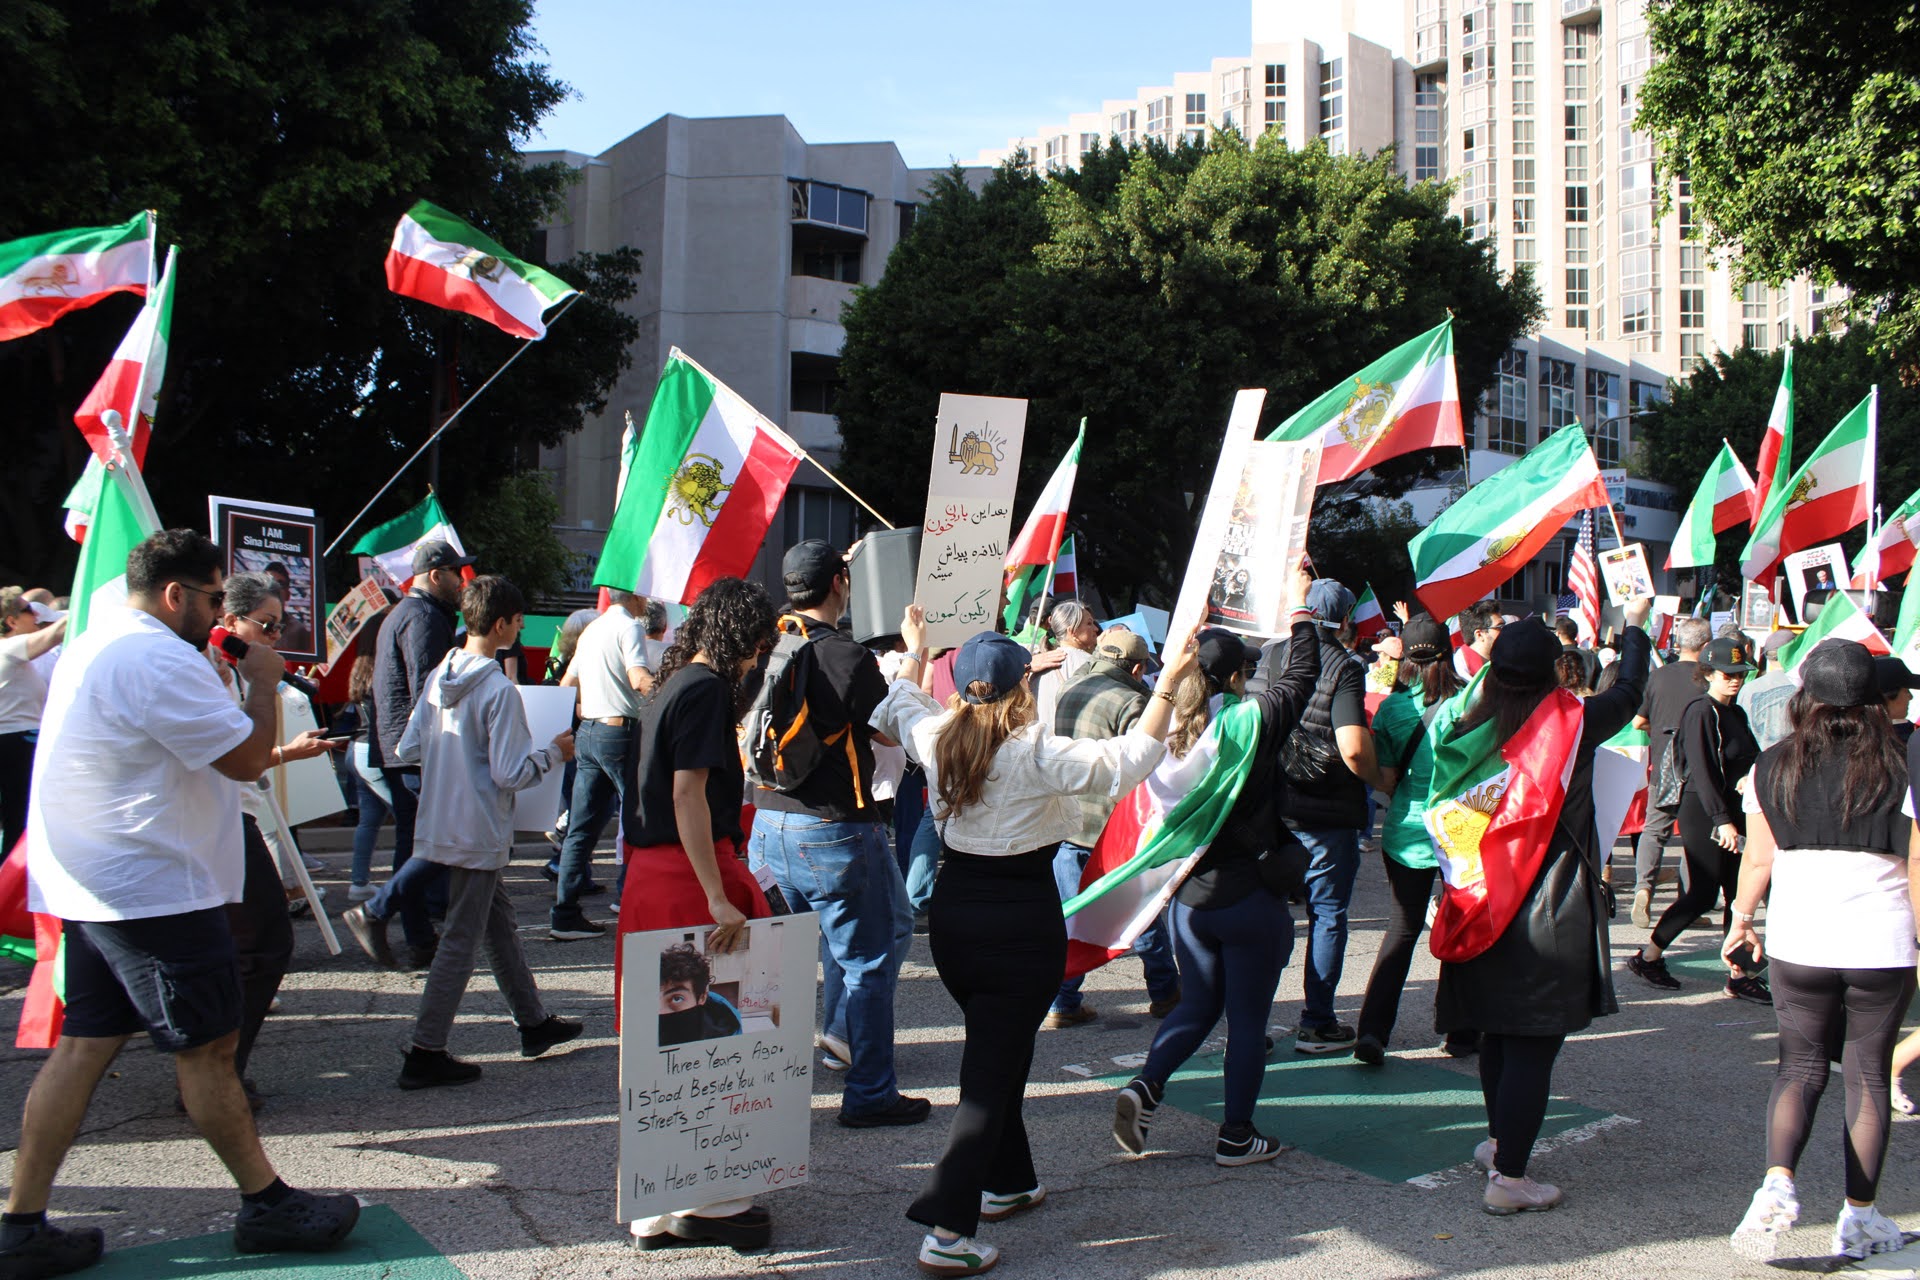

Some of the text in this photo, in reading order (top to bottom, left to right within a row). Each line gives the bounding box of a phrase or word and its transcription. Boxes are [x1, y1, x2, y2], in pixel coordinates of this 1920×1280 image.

[243, 535, 301, 553] Sina Lavasani
[262, 526, 283, 539] I AM
[659, 1048, 701, 1075] Three
[705, 1045, 742, 1069] Years
[628, 1088, 632, 1111] I
[638, 1080, 684, 1107] Stood
[735, 1068, 755, 1090] You
[763, 1070, 775, 1084] in
[782, 1056, 808, 1081] the
[695, 1098, 716, 1121] of
[721, 1093, 773, 1116] Tehran
[634, 1173, 656, 1200] I'm
[664, 1163, 699, 1192] Here
[704, 1158, 719, 1183] to
